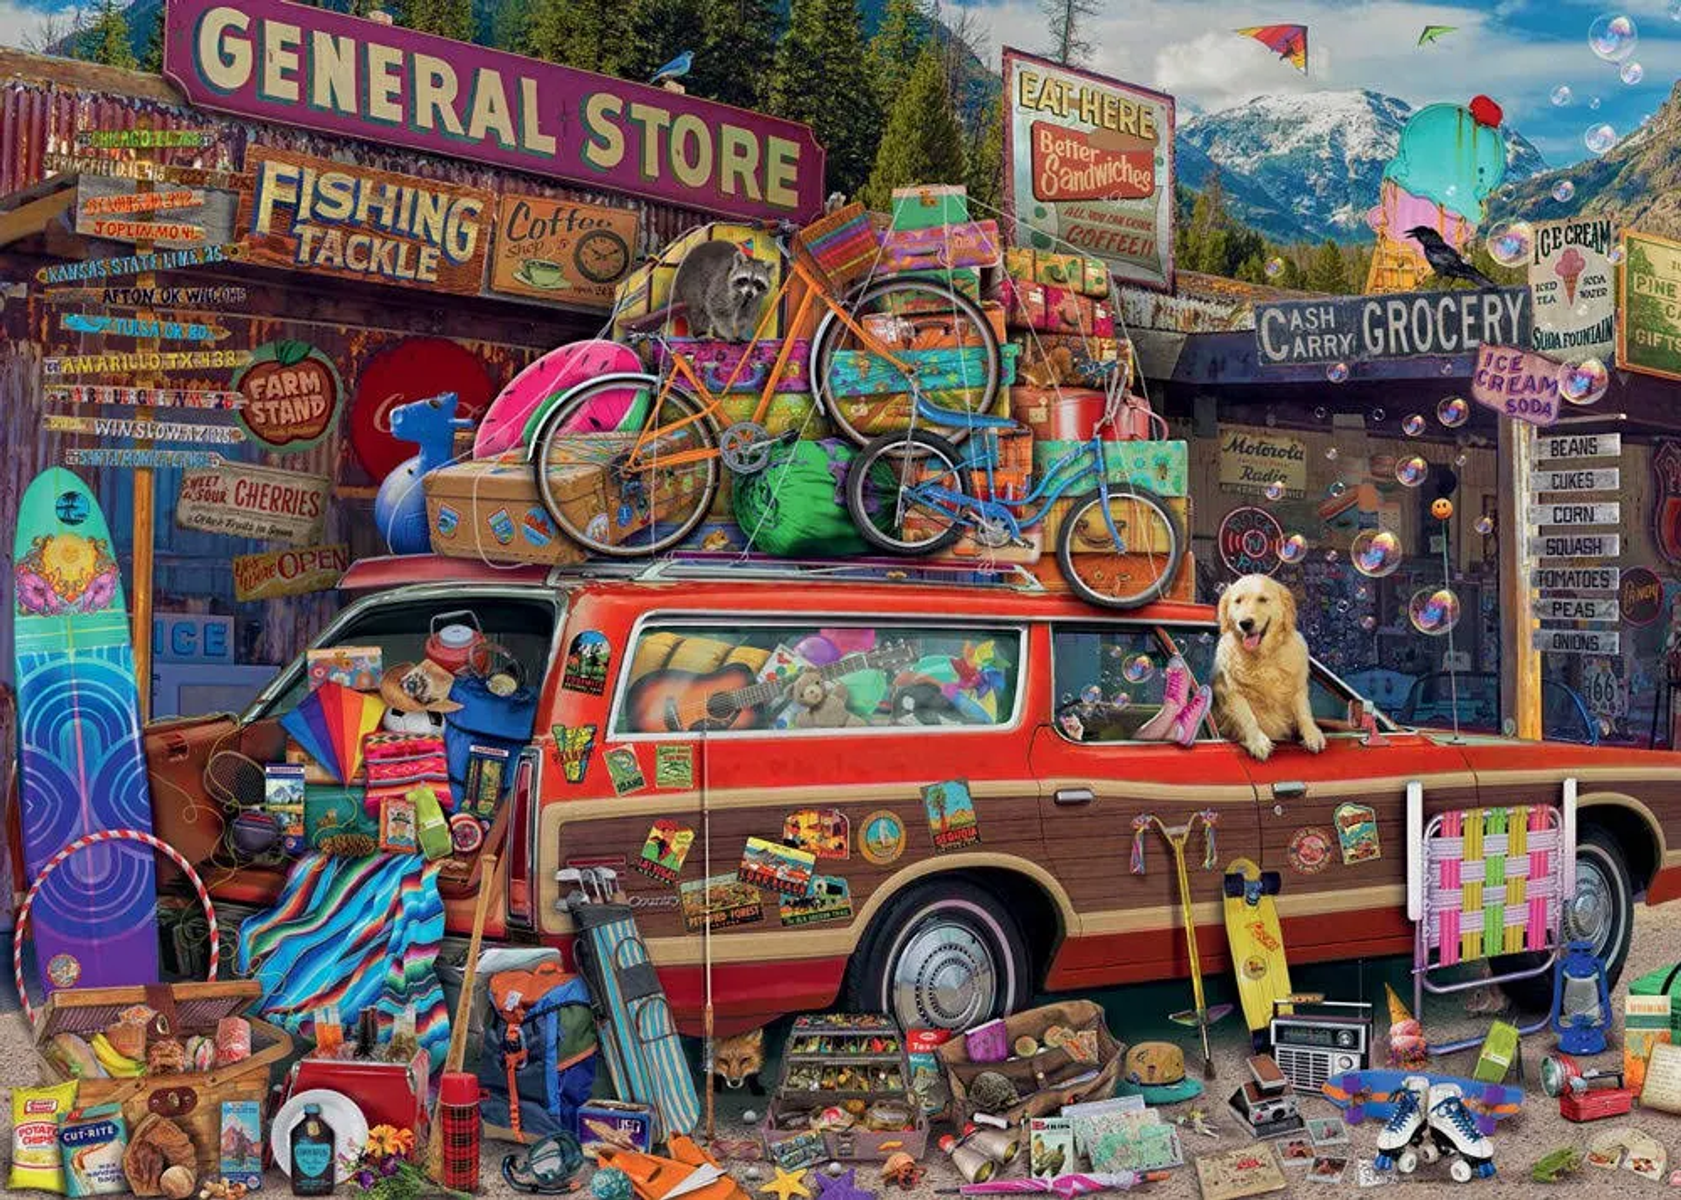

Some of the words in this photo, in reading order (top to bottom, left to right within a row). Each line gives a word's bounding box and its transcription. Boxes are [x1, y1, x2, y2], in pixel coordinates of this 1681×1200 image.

[194, 7, 557, 156] GENERAL
[583, 92, 801, 209] STORE
[1019, 71, 1073, 118] EAT
[1079, 85, 1155, 140] HERE
[1040, 130, 1100, 162] Better
[1041, 154, 1152, 196] Sandwiches
[257, 160, 483, 264] FISHING
[506, 201, 612, 242] Coffee
[295, 224, 442, 284] TACKLE
[1534, 226, 1562, 265] ICE
[1564, 220, 1612, 258] CREAM
[48, 261, 107, 283] KANSAS
[111, 254, 158, 274] STATE
[103, 288, 155, 304] AFTON
[162, 289, 180, 303] OK
[1536, 296, 1557, 305] TEA
[115, 318, 160, 337] TULSA
[1362, 289, 1526, 355] GROCERY
[1563, 315, 1614, 348] FOUNTAIN
[1484, 352, 1523, 374] ICE
[249, 371, 321, 400] FARM
[1475, 369, 1559, 397] CREAM
[251, 394, 326, 425] STAND
[1505, 399, 1553, 418] SODA
[1222, 436, 1304, 460] Motorola
[1550, 437, 1598, 456] BEANS
[1239, 465, 1288, 483] Radio
[1551, 472, 1594, 490] CUKES
[192, 489, 228, 503] SOUR
[235, 478, 322, 518] CHERRIES
[1552, 505, 1595, 523] CORN
[1546, 537, 1602, 556] SQUASH
[277, 549, 349, 579] OPEN
[1537, 569, 1610, 588] TOMATOES
[1552, 602, 1596, 619] PEAS
[154, 619, 228, 657] ICE
[1552, 634, 1600, 651] ONIONS
[63, 1124, 114, 1142] CUT-RITE
